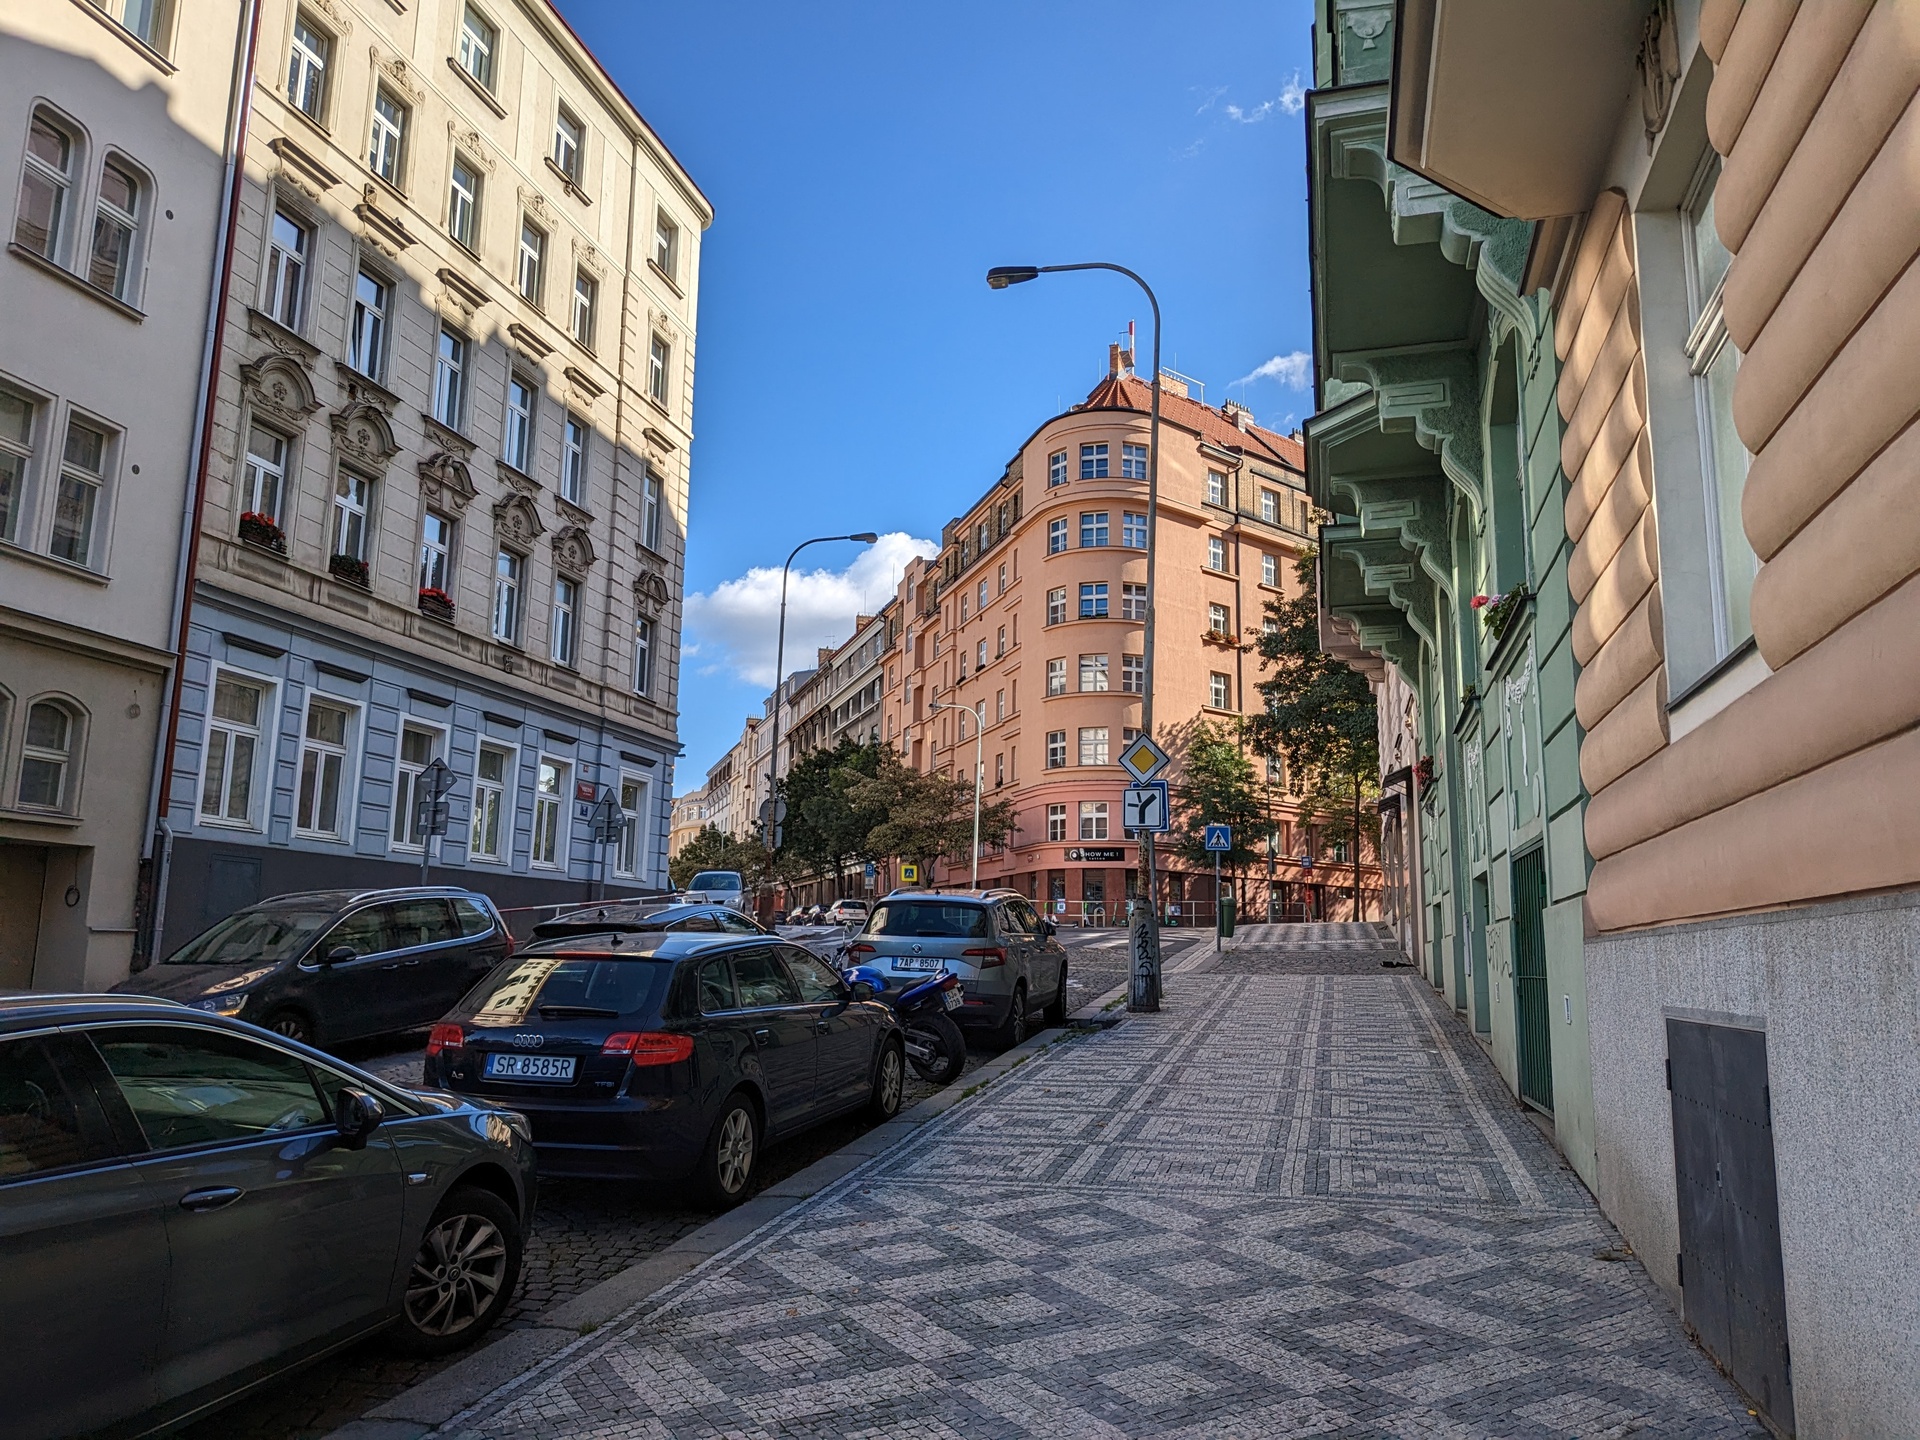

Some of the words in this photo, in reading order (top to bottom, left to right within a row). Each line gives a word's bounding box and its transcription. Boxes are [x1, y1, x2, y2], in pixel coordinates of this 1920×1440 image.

[899, 957, 914, 967] 7AP
[919, 958, 940, 968] 8507
[495, 1056, 517, 1074] SR
[521, 1057, 571, 1077] 8585R
